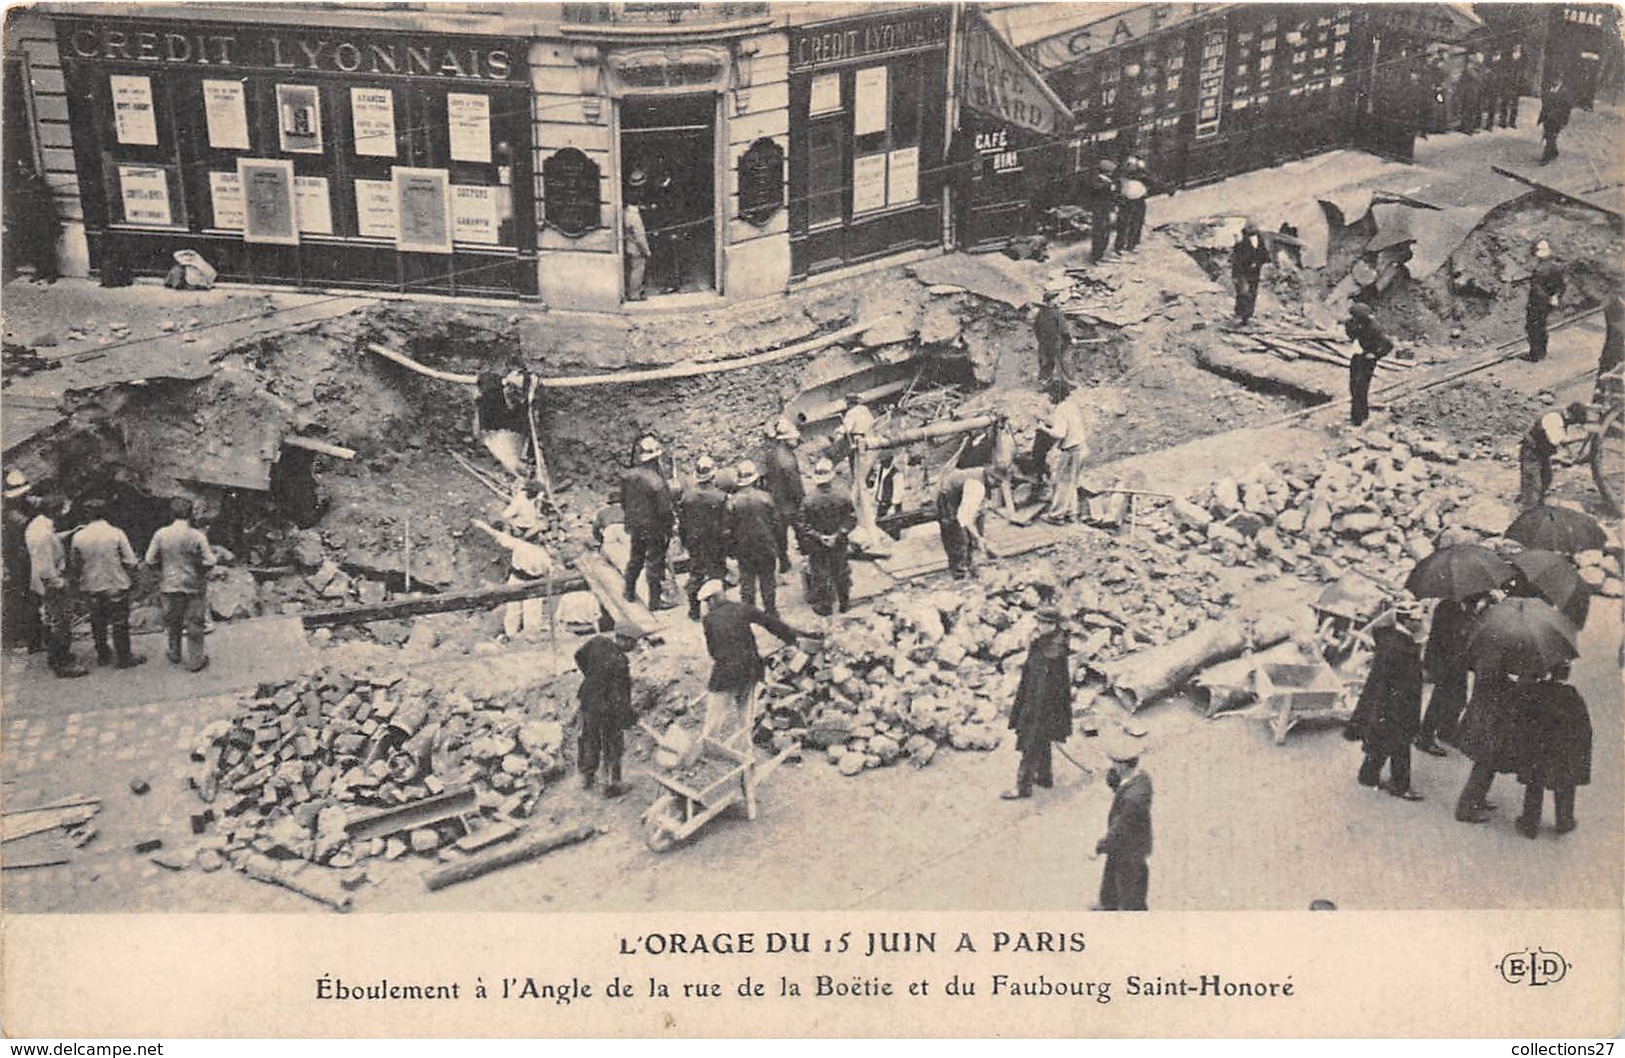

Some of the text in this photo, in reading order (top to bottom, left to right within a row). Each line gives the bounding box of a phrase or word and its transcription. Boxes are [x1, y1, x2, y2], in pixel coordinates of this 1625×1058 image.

[1564, 9, 1602, 26] TABAC
[71, 30, 511, 80] CREDIT LYONNAIS
[798, 30, 858, 65] CREDIT
[975, 129, 1008, 149] CAFÉ
